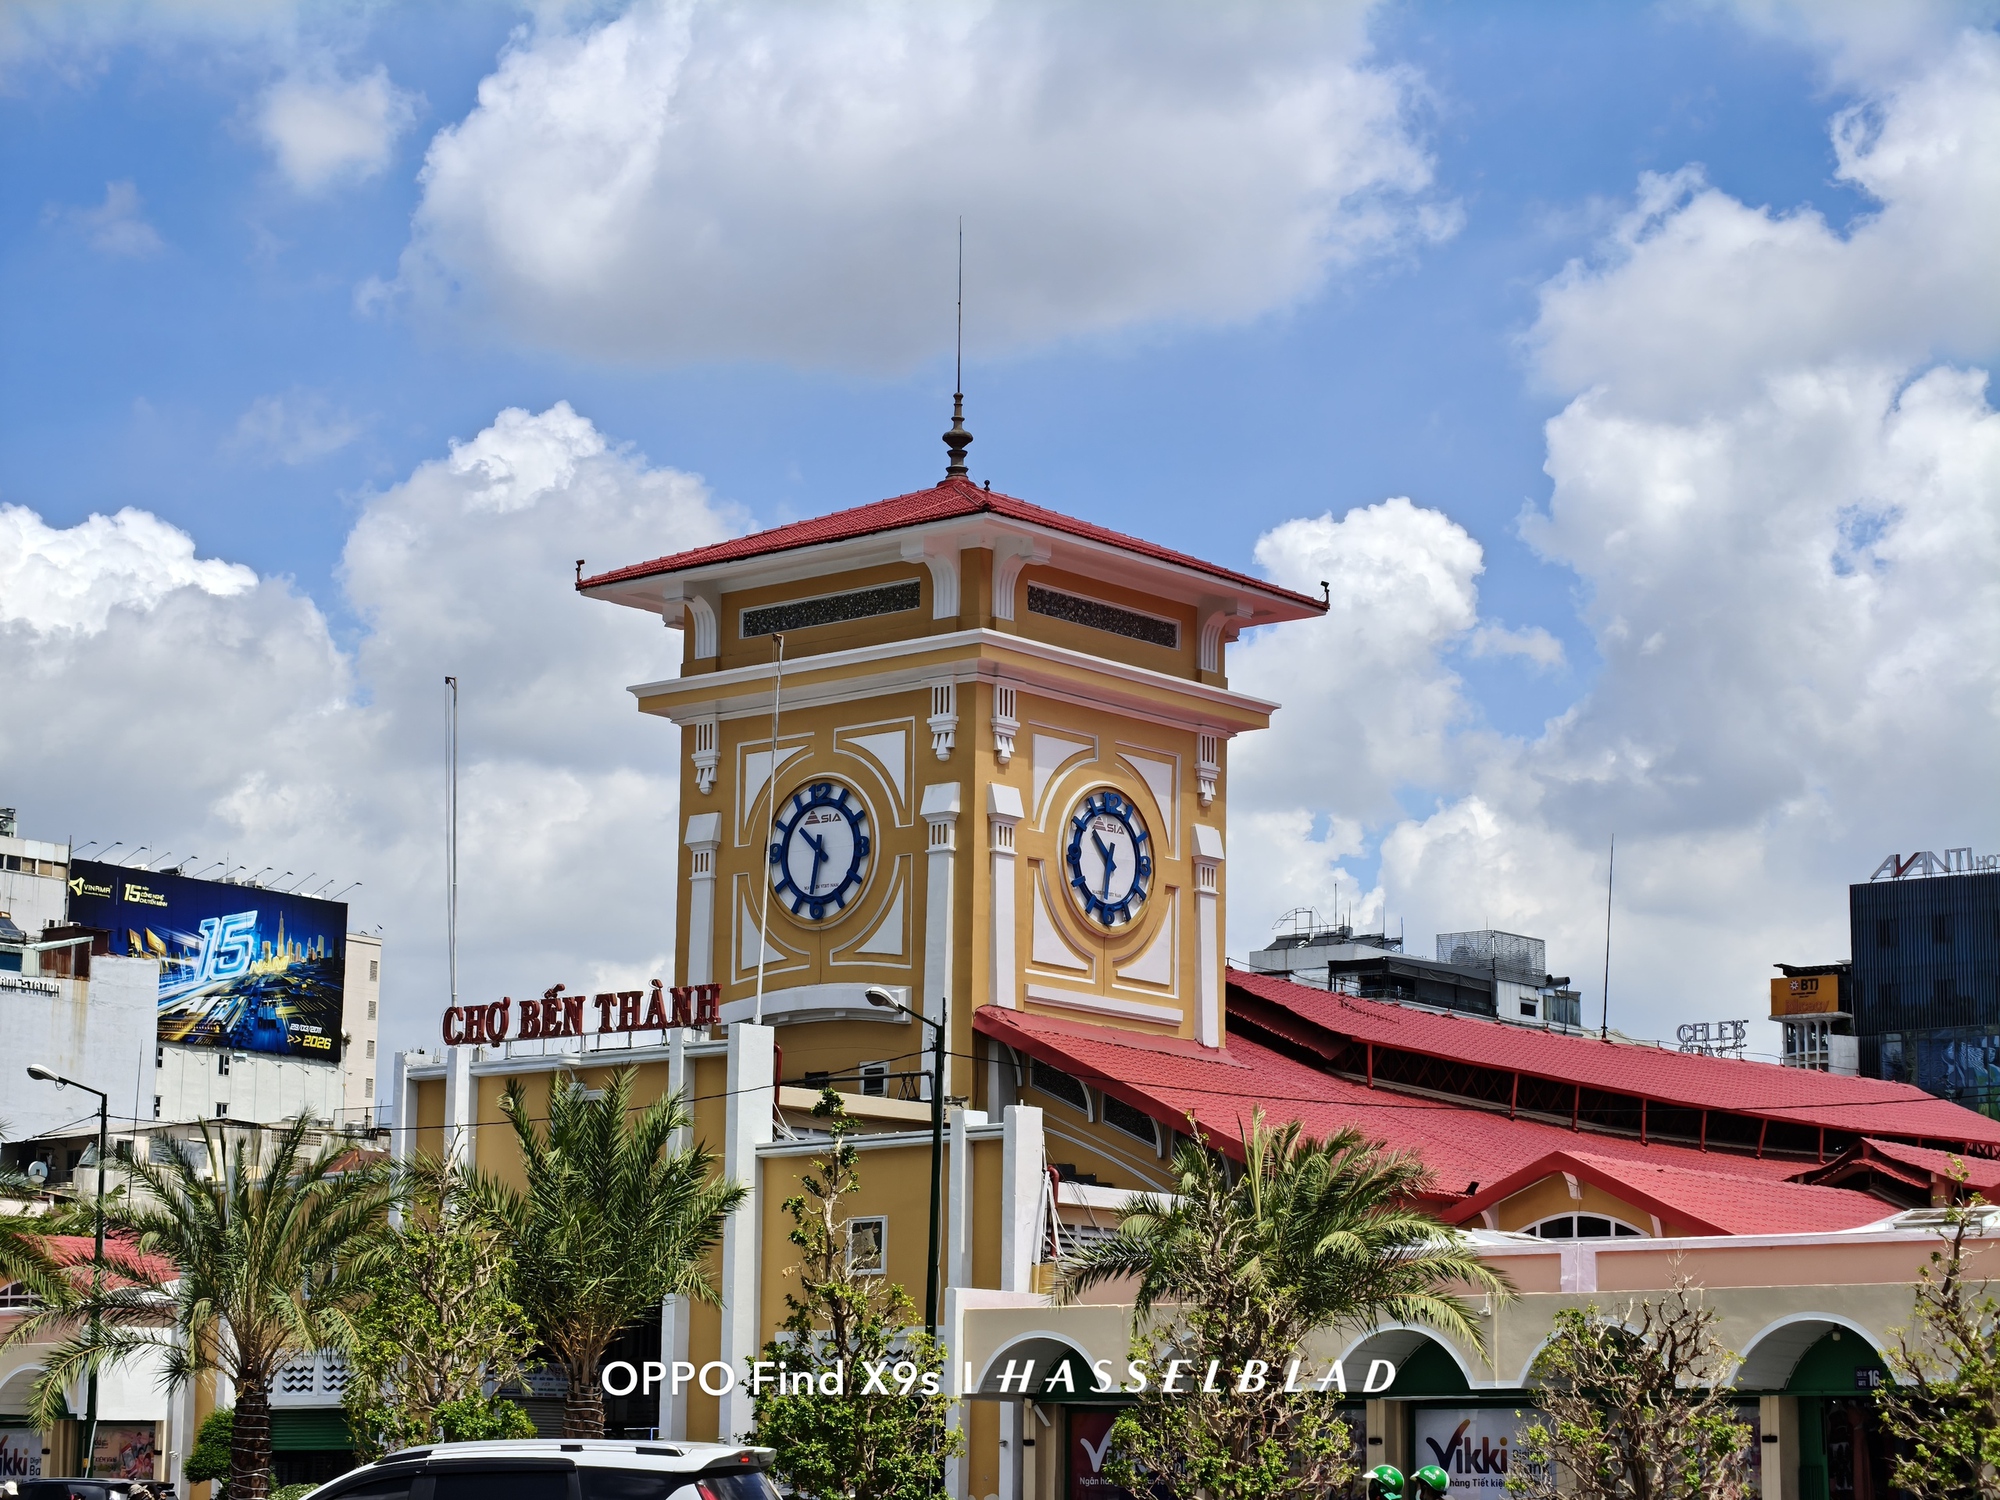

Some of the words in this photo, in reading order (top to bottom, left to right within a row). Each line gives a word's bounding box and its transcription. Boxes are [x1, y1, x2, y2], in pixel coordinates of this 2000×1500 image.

[809, 783, 832, 806] 12
[1103, 791, 1123, 814] 12
[804, 810, 842, 826] ASIA
[1092, 815, 1125, 836] ASIA
[770, 843, 783, 864] 9
[856, 836, 870, 857] 3
[1066, 843, 1082, 865] 9
[1139, 855, 1152, 877] 3
[1870, 847, 1972, 880] AVANTI
[1975, 854, 2000, 869] HO
[124, 883, 142, 902] 15
[809, 898, 825, 920] 6
[1101, 904, 1115, 925] 6
[194, 910, 258, 984] 15
[1800, 978, 1819, 991] BTJ
[442, 997, 511, 1048] CHỢ
[518, 983, 586, 1039] BẾN
[593, 979, 722, 1034] THÀNH
[302, 1034, 332, 1050] 2026
[1868, 1369, 1880, 1387] 16
[1426, 1418, 1508, 1474] Vikki
[1079, 1476, 1099, 1487] Ngân
[1382, 1473, 1396, 1486] Grab
[1423, 1469, 1437, 1480] Grab
[1450, 1478, 1470, 1489] hàng
[1472, 1476, 1489, 1487] Tiết
[1491, 1478, 1506, 1488] kiệ
